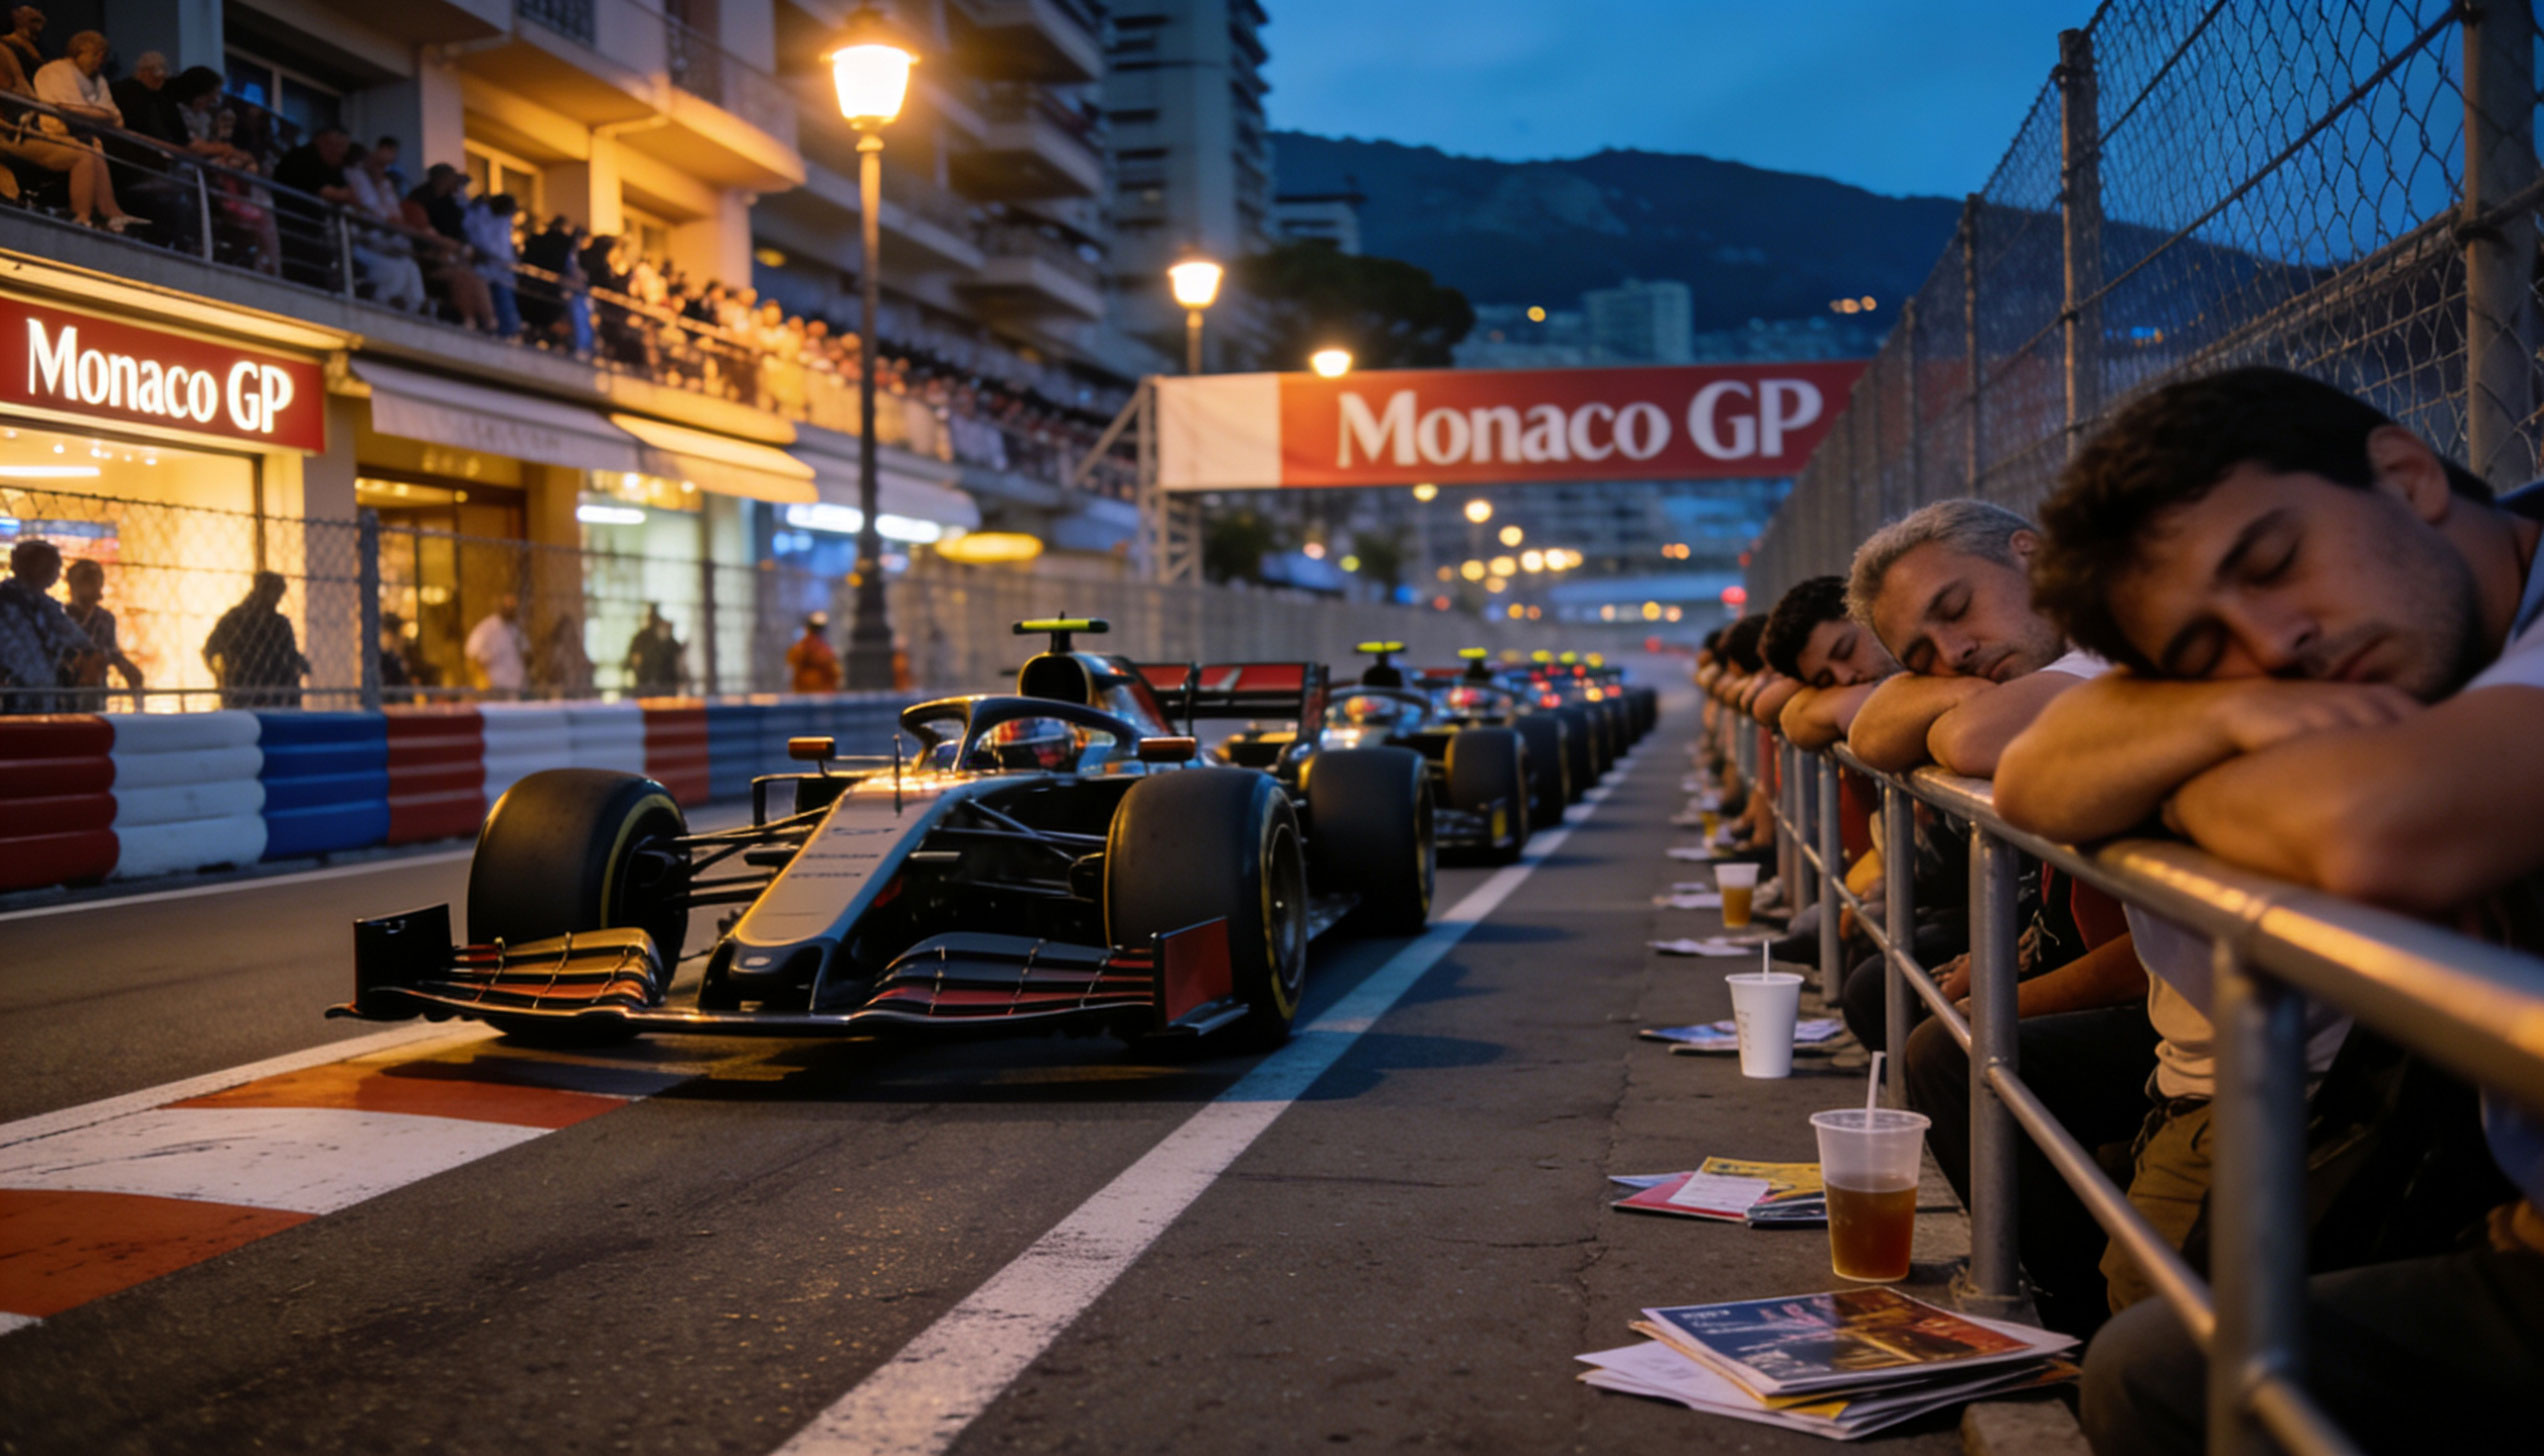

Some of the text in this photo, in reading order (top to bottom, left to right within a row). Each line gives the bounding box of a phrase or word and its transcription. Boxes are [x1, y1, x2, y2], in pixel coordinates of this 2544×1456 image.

[26, 317, 295, 434] Monaco GP
[1336, 378, 1824, 468] Monaco GP
